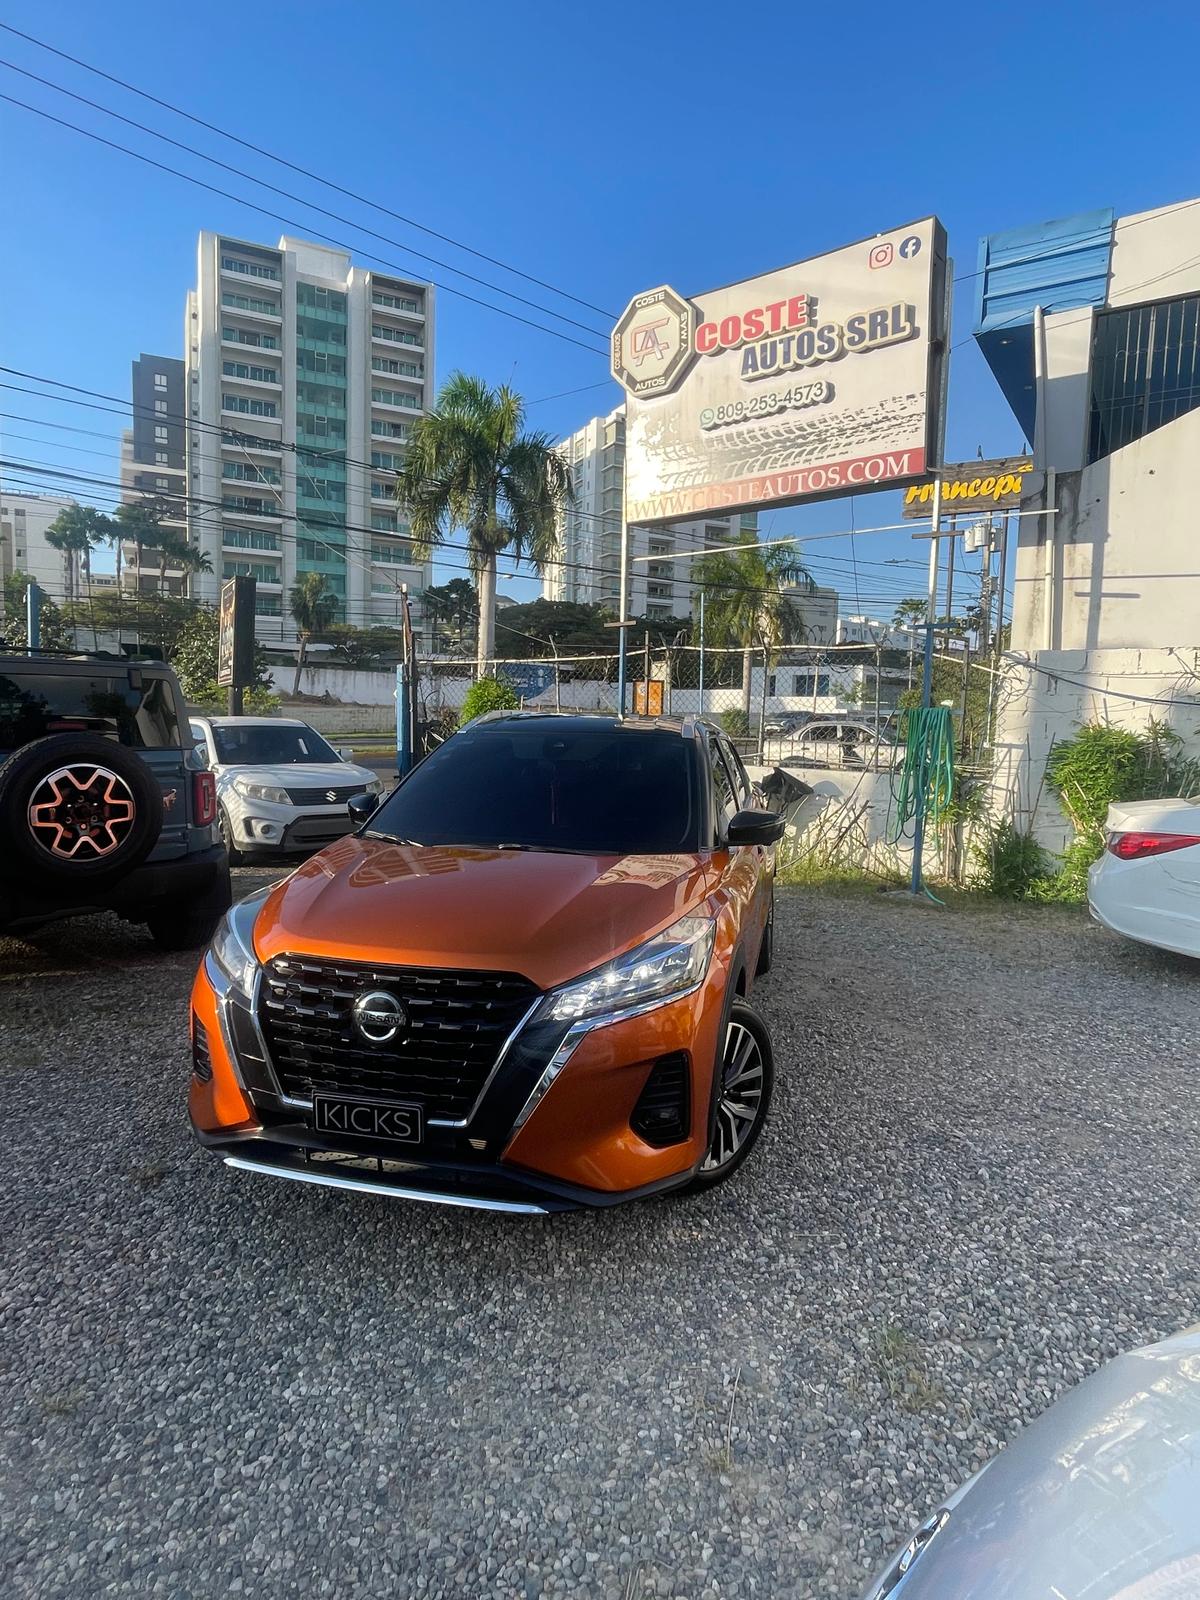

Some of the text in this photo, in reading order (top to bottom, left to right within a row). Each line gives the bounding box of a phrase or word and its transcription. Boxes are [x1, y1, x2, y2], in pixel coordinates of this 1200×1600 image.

[635, 291, 665, 308] COSTE
[680, 311, 688, 340] MAS
[696, 294, 806, 353] COSTE
[741, 303, 907, 377] AUTOS SRL
[634, 377, 666, 392] AUTOS
[716, 382, 824, 421] 809-253-4573
[634, 453, 911, 518] WWW.COSTEAUTOS.COM
[359, 1012, 400, 1025] NISSAN
[324, 1103, 411, 1136] KICKS
